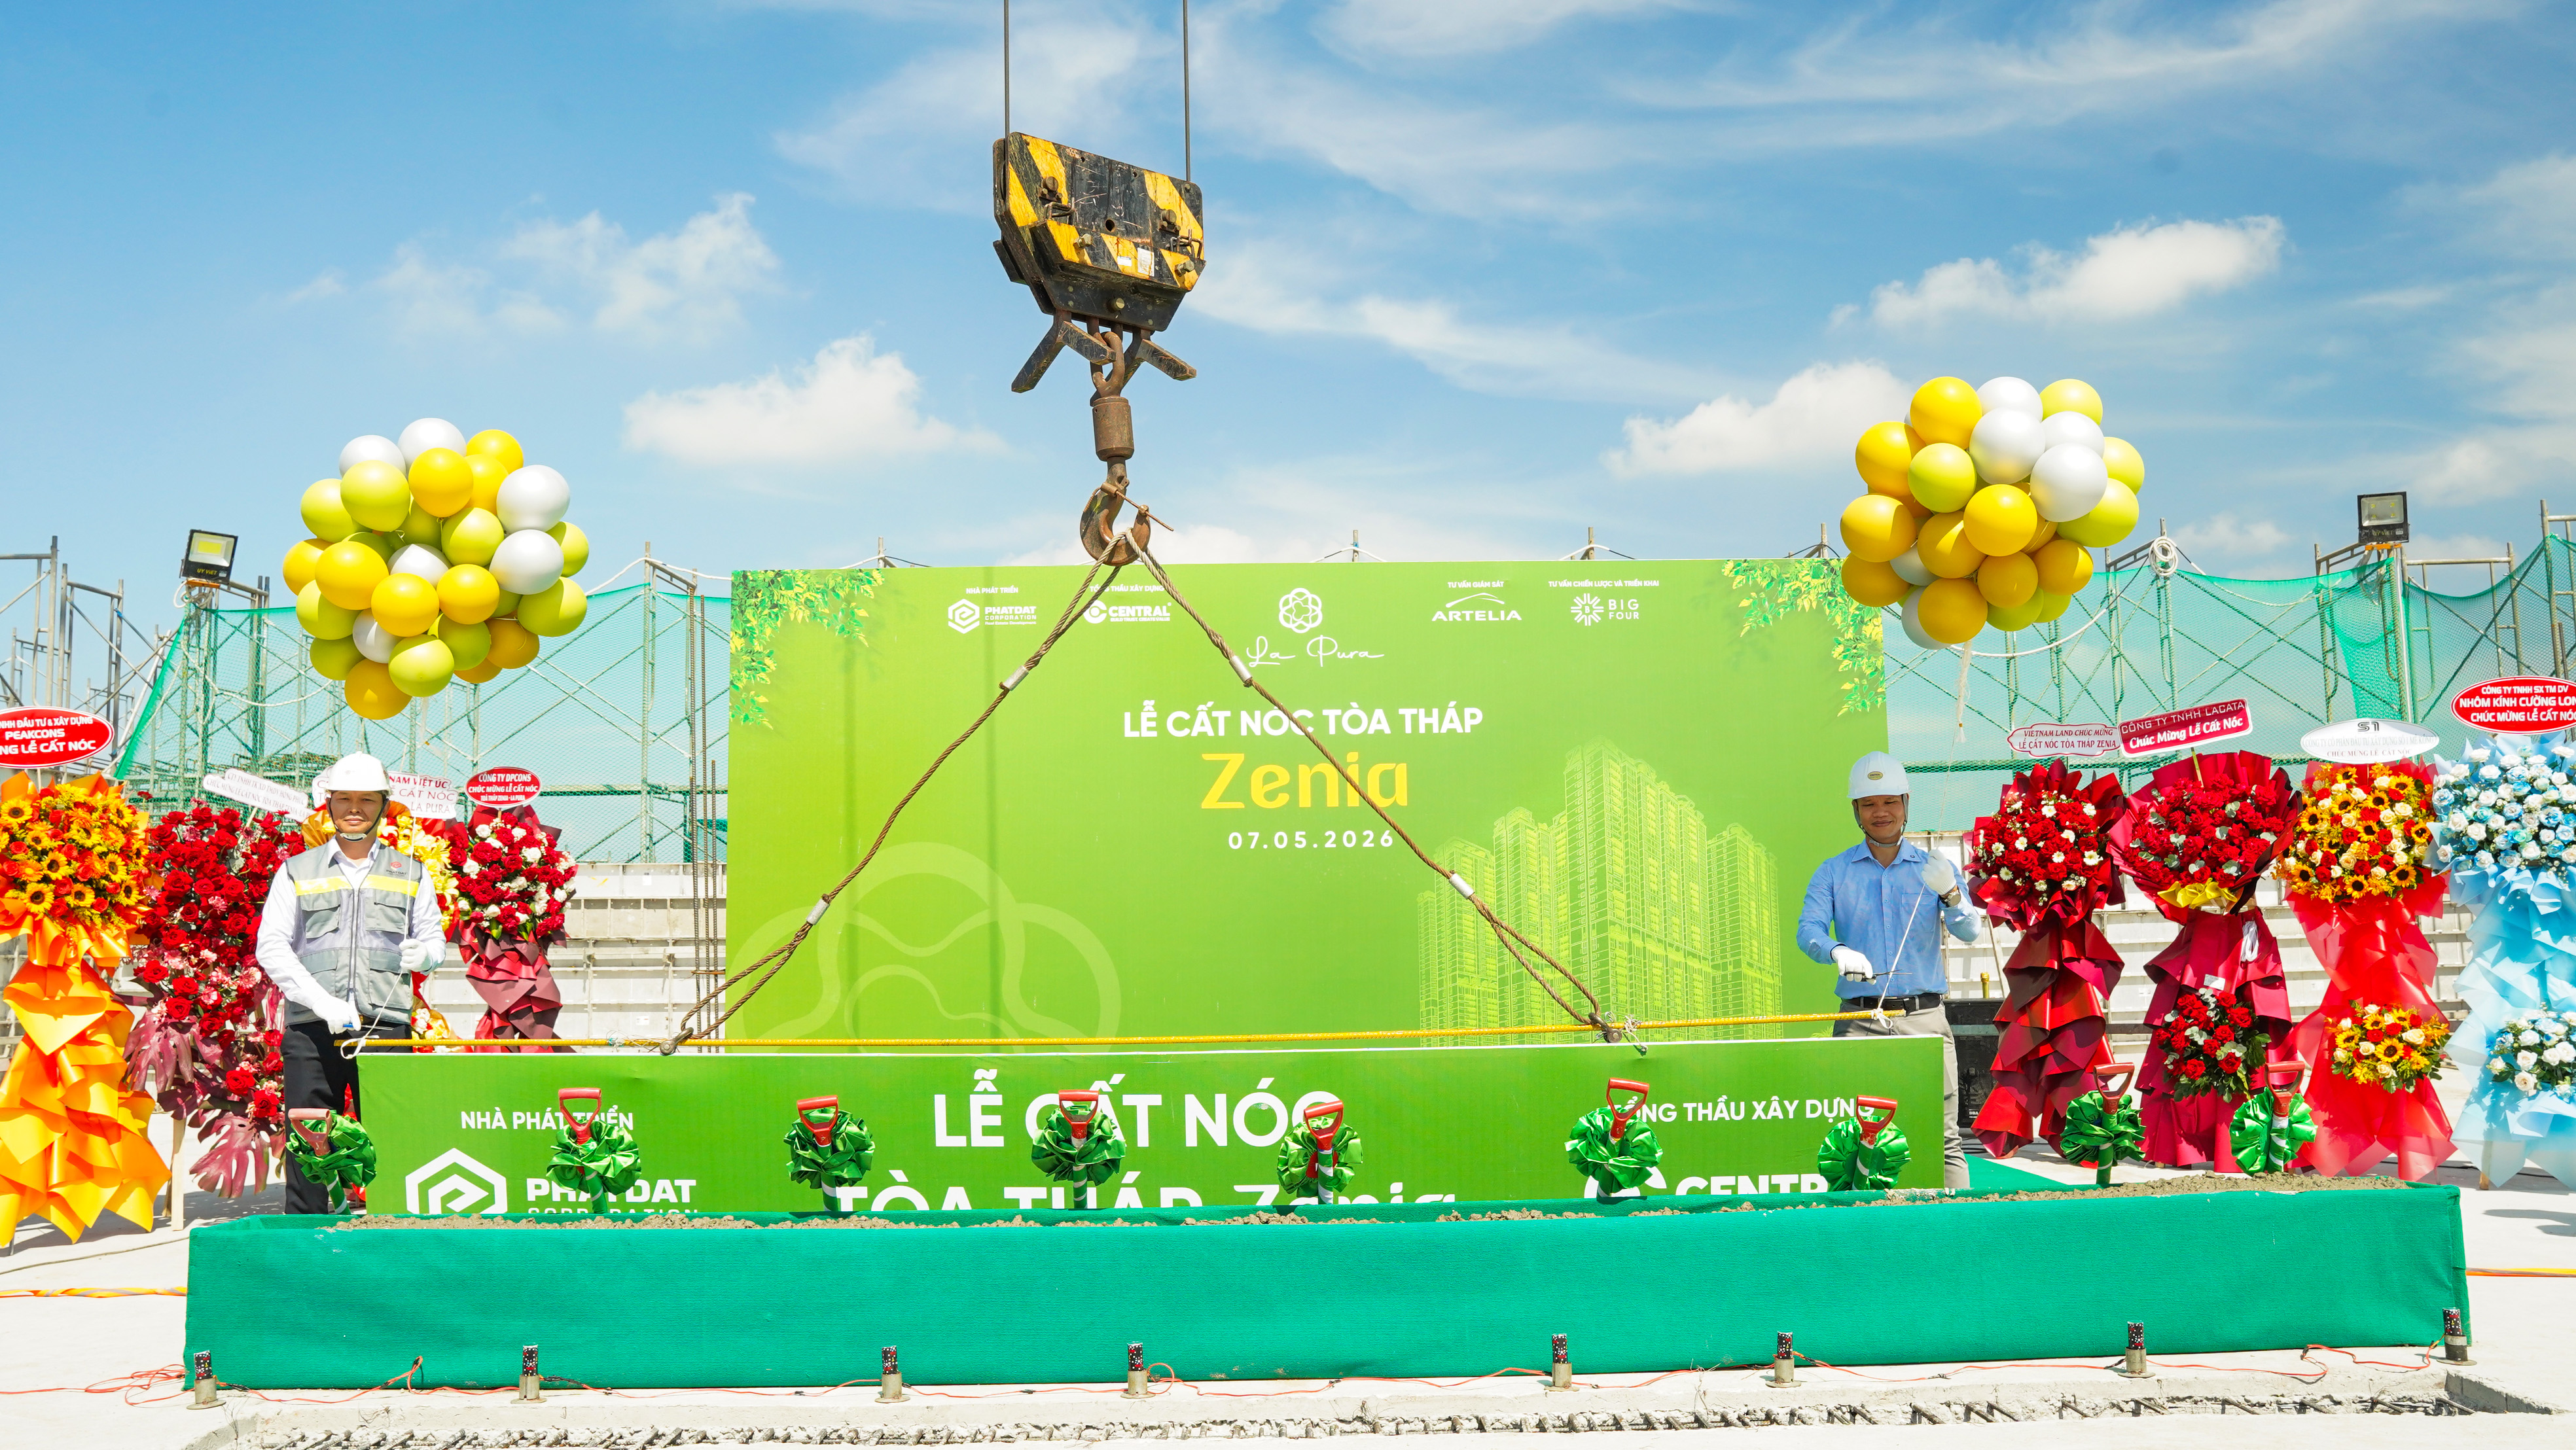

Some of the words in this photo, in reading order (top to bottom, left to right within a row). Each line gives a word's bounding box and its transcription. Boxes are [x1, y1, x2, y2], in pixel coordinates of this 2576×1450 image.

[1609, 599, 1639, 610] BIG
[1109, 605, 1170, 617] CENTRAL
[1432, 610, 1522, 621] ARTELIA
[1246, 636, 1296, 667] La
[1307, 635, 1384, 667] Pura
[2481, 685, 2501, 694] CÔNG
[2460, 696, 2490, 707] NHÔM
[2493, 696, 2517, 707] KÍNH
[2519, 695, 2556, 707] CƯỜNG
[2558, 696, 2576, 706] LON
[1124, 699, 1158, 737] LỄ
[1166, 701, 1231, 737] CẤT
[1240, 705, 1314, 736] NÓC
[1322, 702, 1391, 735] TÒA
[1399, 701, 1483, 734] THÁP
[2121, 720, 2152, 734] CÔNG
[2155, 716, 2167, 726] TY
[2171, 710, 2201, 723] TNHH
[2205, 701, 2245, 716] LACATA
[2471, 711, 2496, 722] CHÚC
[2497, 710, 2526, 722] MỪNG
[2527, 708, 2538, 721] LỄ
[2540, 708, 2558, 720] CẤT
[35, 718, 46, 727] TƯ
[54, 716, 69, 726] XÂY
[70, 716, 93, 726] DỰNG
[2357, 722, 2379, 732] S1
[5, 728, 65, 740] PEAKCONS
[2075, 728, 2092, 736] CHÚC
[2130, 734, 2155, 749] Chúc
[2157, 730, 2186, 743] Mừng
[2189, 722, 2201, 736] Lễ
[2202, 718, 2221, 734] Cất
[2223, 716, 2243, 730] Nóc
[0, 745, 18, 755] NG
[21, 740, 37, 754] LỄ
[40, 739, 66, 752] CẤT
[68, 739, 96, 751] NÓC
[2029, 737, 2043, 749] CẤT
[2045, 739, 2058, 749] NÓC
[2061, 738, 2075, 748] TÒA
[2077, 738, 2095, 748] THÁP
[2320, 738, 2327, 747] TY
[435, 777, 448, 788] ÚC
[478, 772, 496, 782] CÔNG
[506, 773, 531, 782] DPCONS
[1201, 751, 1408, 809] Zenia
[399, 786, 424, 798] CẤT
[427, 790, 456, 801] NÓC
[506, 783, 512, 792] LỄ
[425, 803, 451, 813] PURA
[1228, 830, 1393, 849] 07.05.2026
[934, 1069, 1005, 1147] LỄ
[1608, 1095, 1677, 1123] ỔNG
[1683, 1095, 1745, 1122] THẦU
[1752, 1095, 1799, 1120] XÂY
[1806, 1097, 1874, 1123] DỰNG
[461, 1107, 507, 1129] NHÀ
[512, 1107, 565, 1130] PHÁT
[573, 1105, 634, 1131] TIỂN
